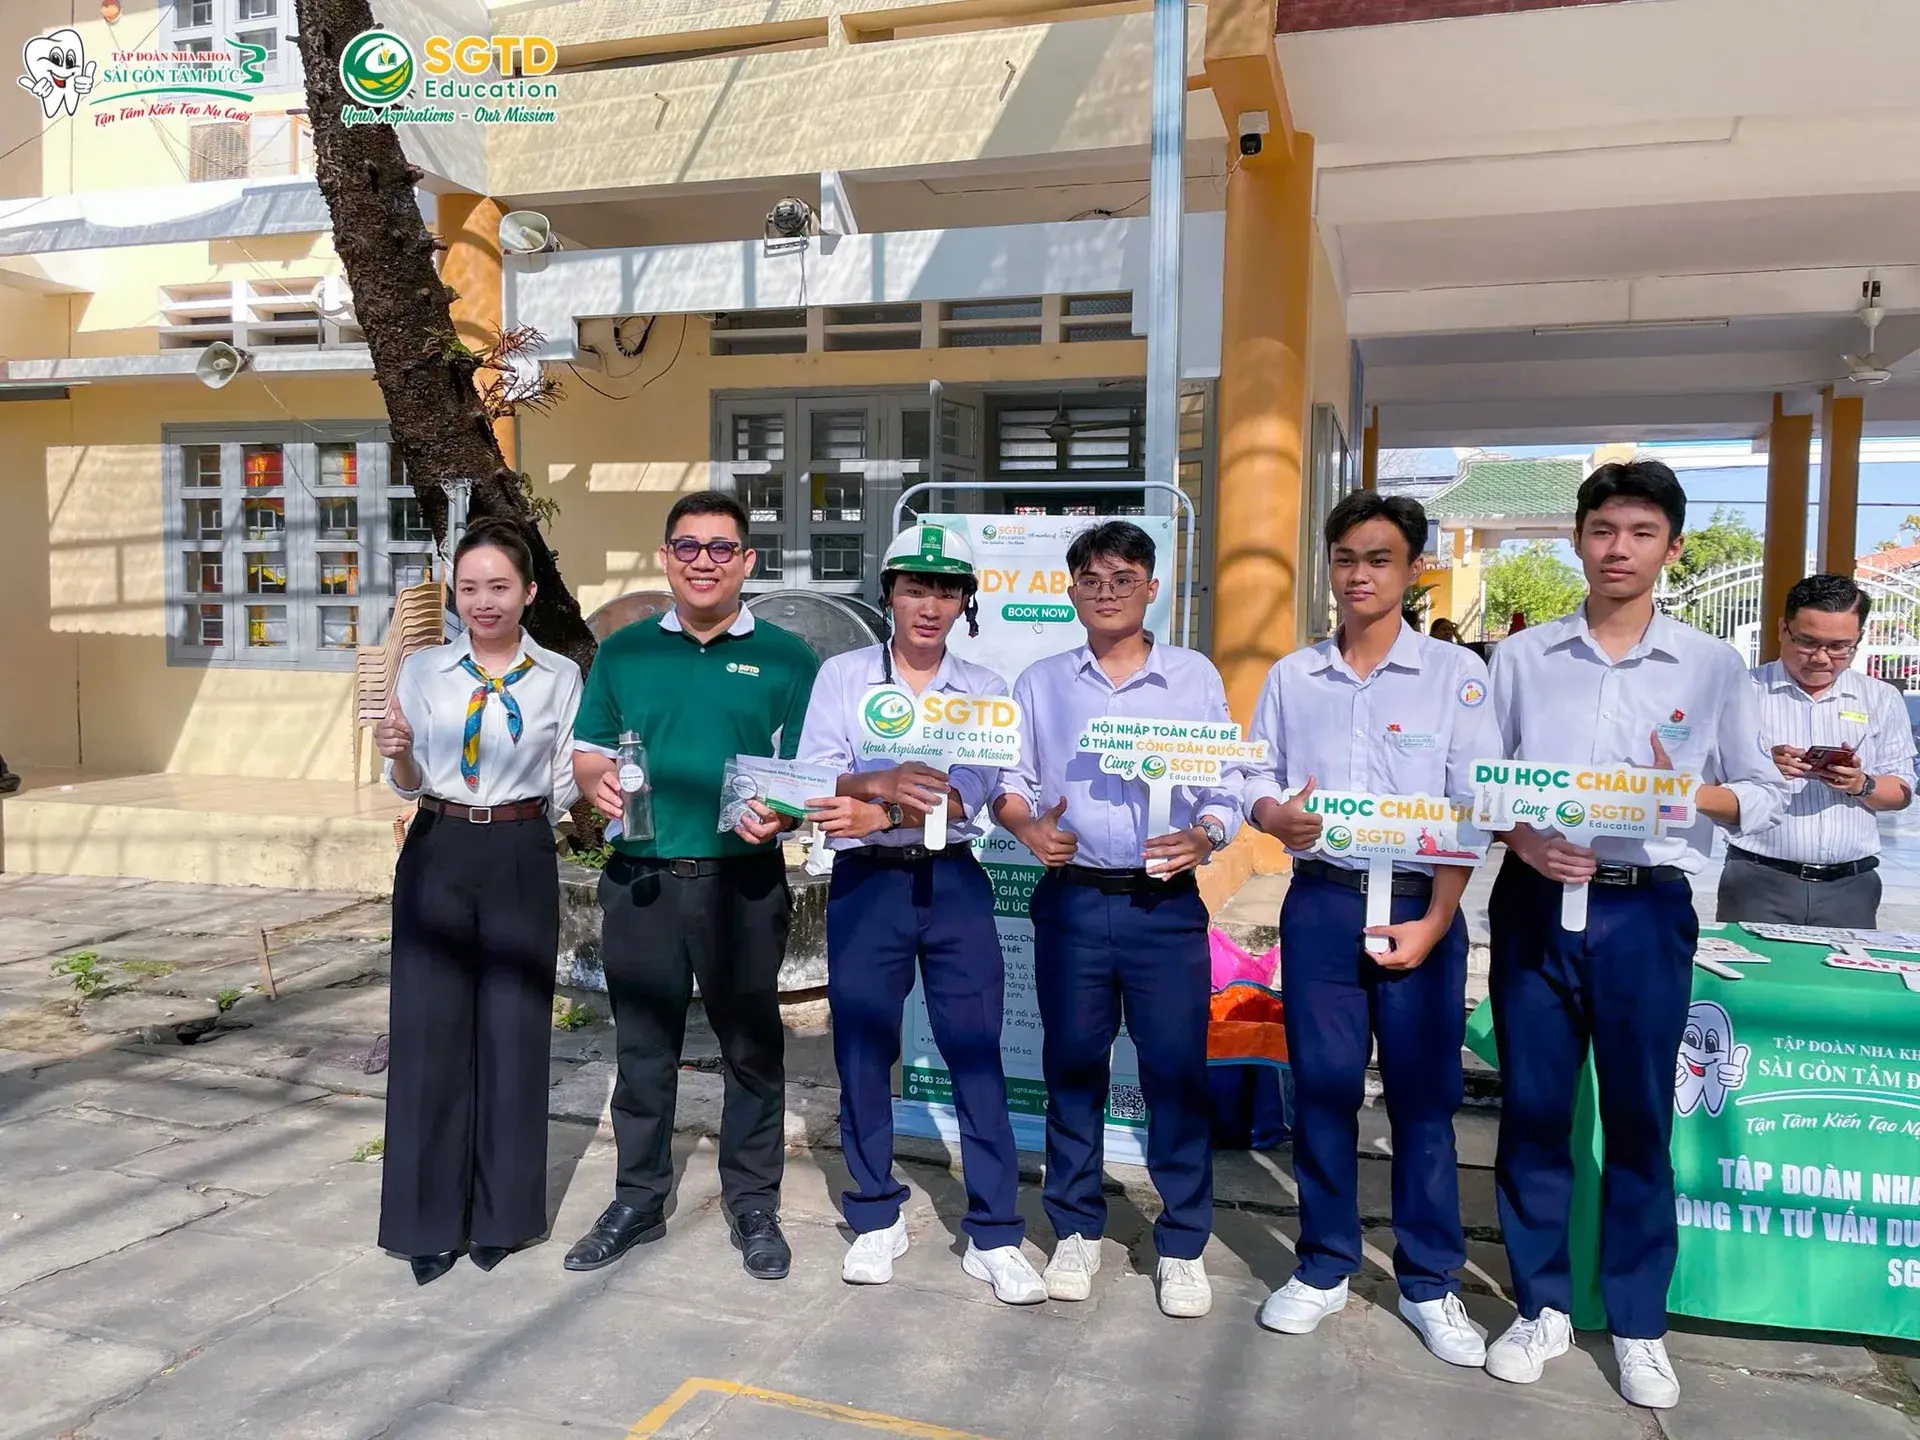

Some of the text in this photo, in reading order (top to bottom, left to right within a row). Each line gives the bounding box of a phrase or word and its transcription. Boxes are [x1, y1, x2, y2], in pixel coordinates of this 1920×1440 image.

[1028, 570, 1073, 594] AB
[1007, 607, 1070, 618] BOOK NOW
[923, 696, 1015, 728] SGTD
[923, 726, 1015, 745] Education
[1091, 721, 1114, 735] HỘI
[1117, 723, 1150, 739] NHẬP
[1152, 724, 1187, 739] TOÀN
[1220, 726, 1238, 741] ĐỂ
[862, 741, 888, 756] Your
[888, 742, 944, 759] Aspirations
[956, 746, 976, 759] Our
[977, 749, 1014, 761] Mission
[1079, 734, 1266, 759] Ở THÀNH CÔNG DÂN QUỐC TẾ
[1104, 754, 1217, 776] Cùng SGTD
[1169, 773, 1217, 783] Education
[1475, 765, 1695, 797] DU HỌC CHÂU MỸ
[1304, 797, 1319, 813] U
[1323, 797, 1374, 820] HỌC
[1379, 798, 1444, 821] CHÂU
[1512, 799, 1646, 822] Cùng SGTD
[1589, 820, 1645, 832] Education
[989, 839, 1017, 853] HỌC
[1356, 829, 1406, 846] SGTD
[1355, 844, 1407, 855] Education
[988, 869, 1008, 881] GIA
[999, 885, 1020, 897] GIA
[993, 898, 1030, 913] ÂU ÚC
[1003, 933, 1019, 942] các
[1773, 1035, 1805, 1053] TẬP
[1808, 1039, 1855, 1056] ĐOÀN
[1859, 1044, 1894, 1059] NHA
[1758, 1055, 1793, 1079] SÀI
[1798, 1059, 1847, 1083] GÒN
[1852, 1063, 1901, 1089] TÂM
[1745, 1117, 1776, 1136] Tận
[1781, 1113, 1818, 1131] Tâm
[1822, 1112, 1861, 1129] Kiến
[1868, 1114, 1898, 1135] Tạo
[1718, 1154, 1773, 1196] TẬP
[1781, 1163, 1861, 1201] ĐOÀN
[1676, 1193, 1920, 1248] ÔNG TY TƯ VẤN DU
